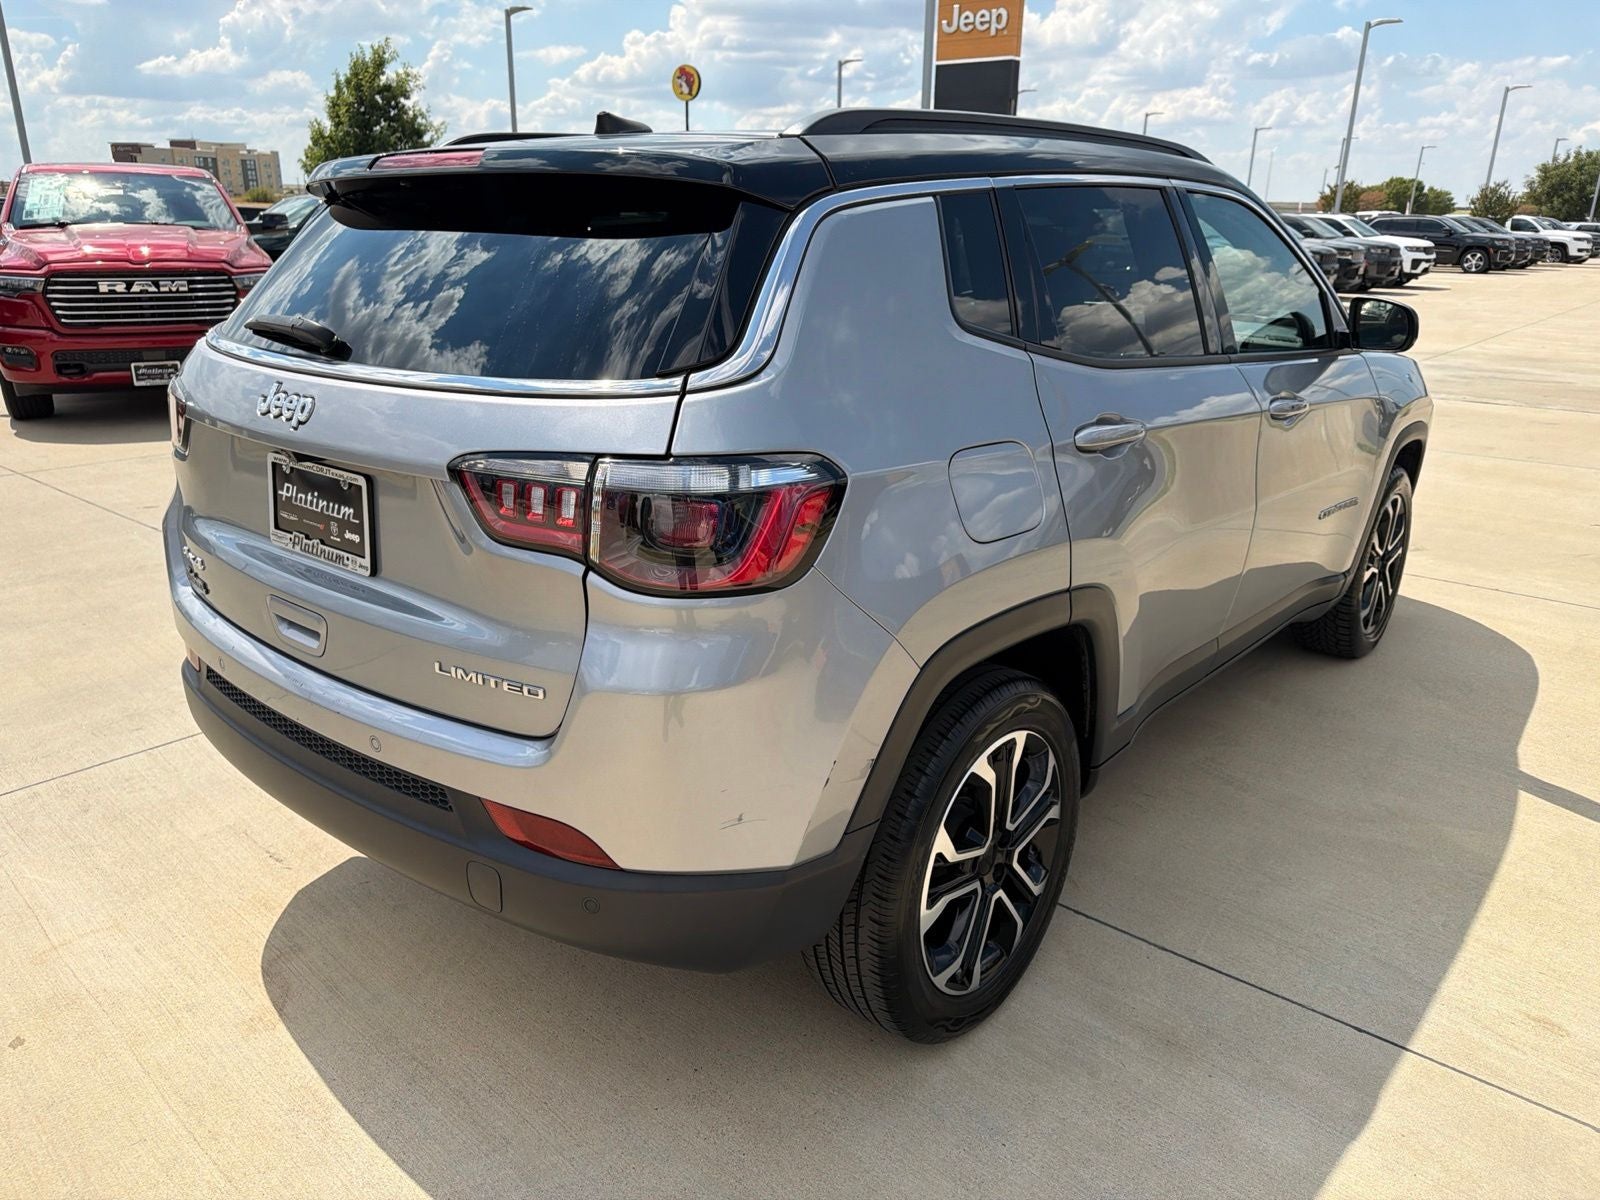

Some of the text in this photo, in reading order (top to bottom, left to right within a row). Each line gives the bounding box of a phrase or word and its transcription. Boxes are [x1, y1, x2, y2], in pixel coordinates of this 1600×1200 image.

[941, 4, 1008, 36] Jeep
[97, 281, 188, 294] RAM
[256, 381, 315, 430] Jeep
[278, 482, 360, 523] Platinum
[292, 532, 350, 567] Platinum
[344, 529, 361, 544] Jeep
[434, 660, 547, 700] LIMITED
